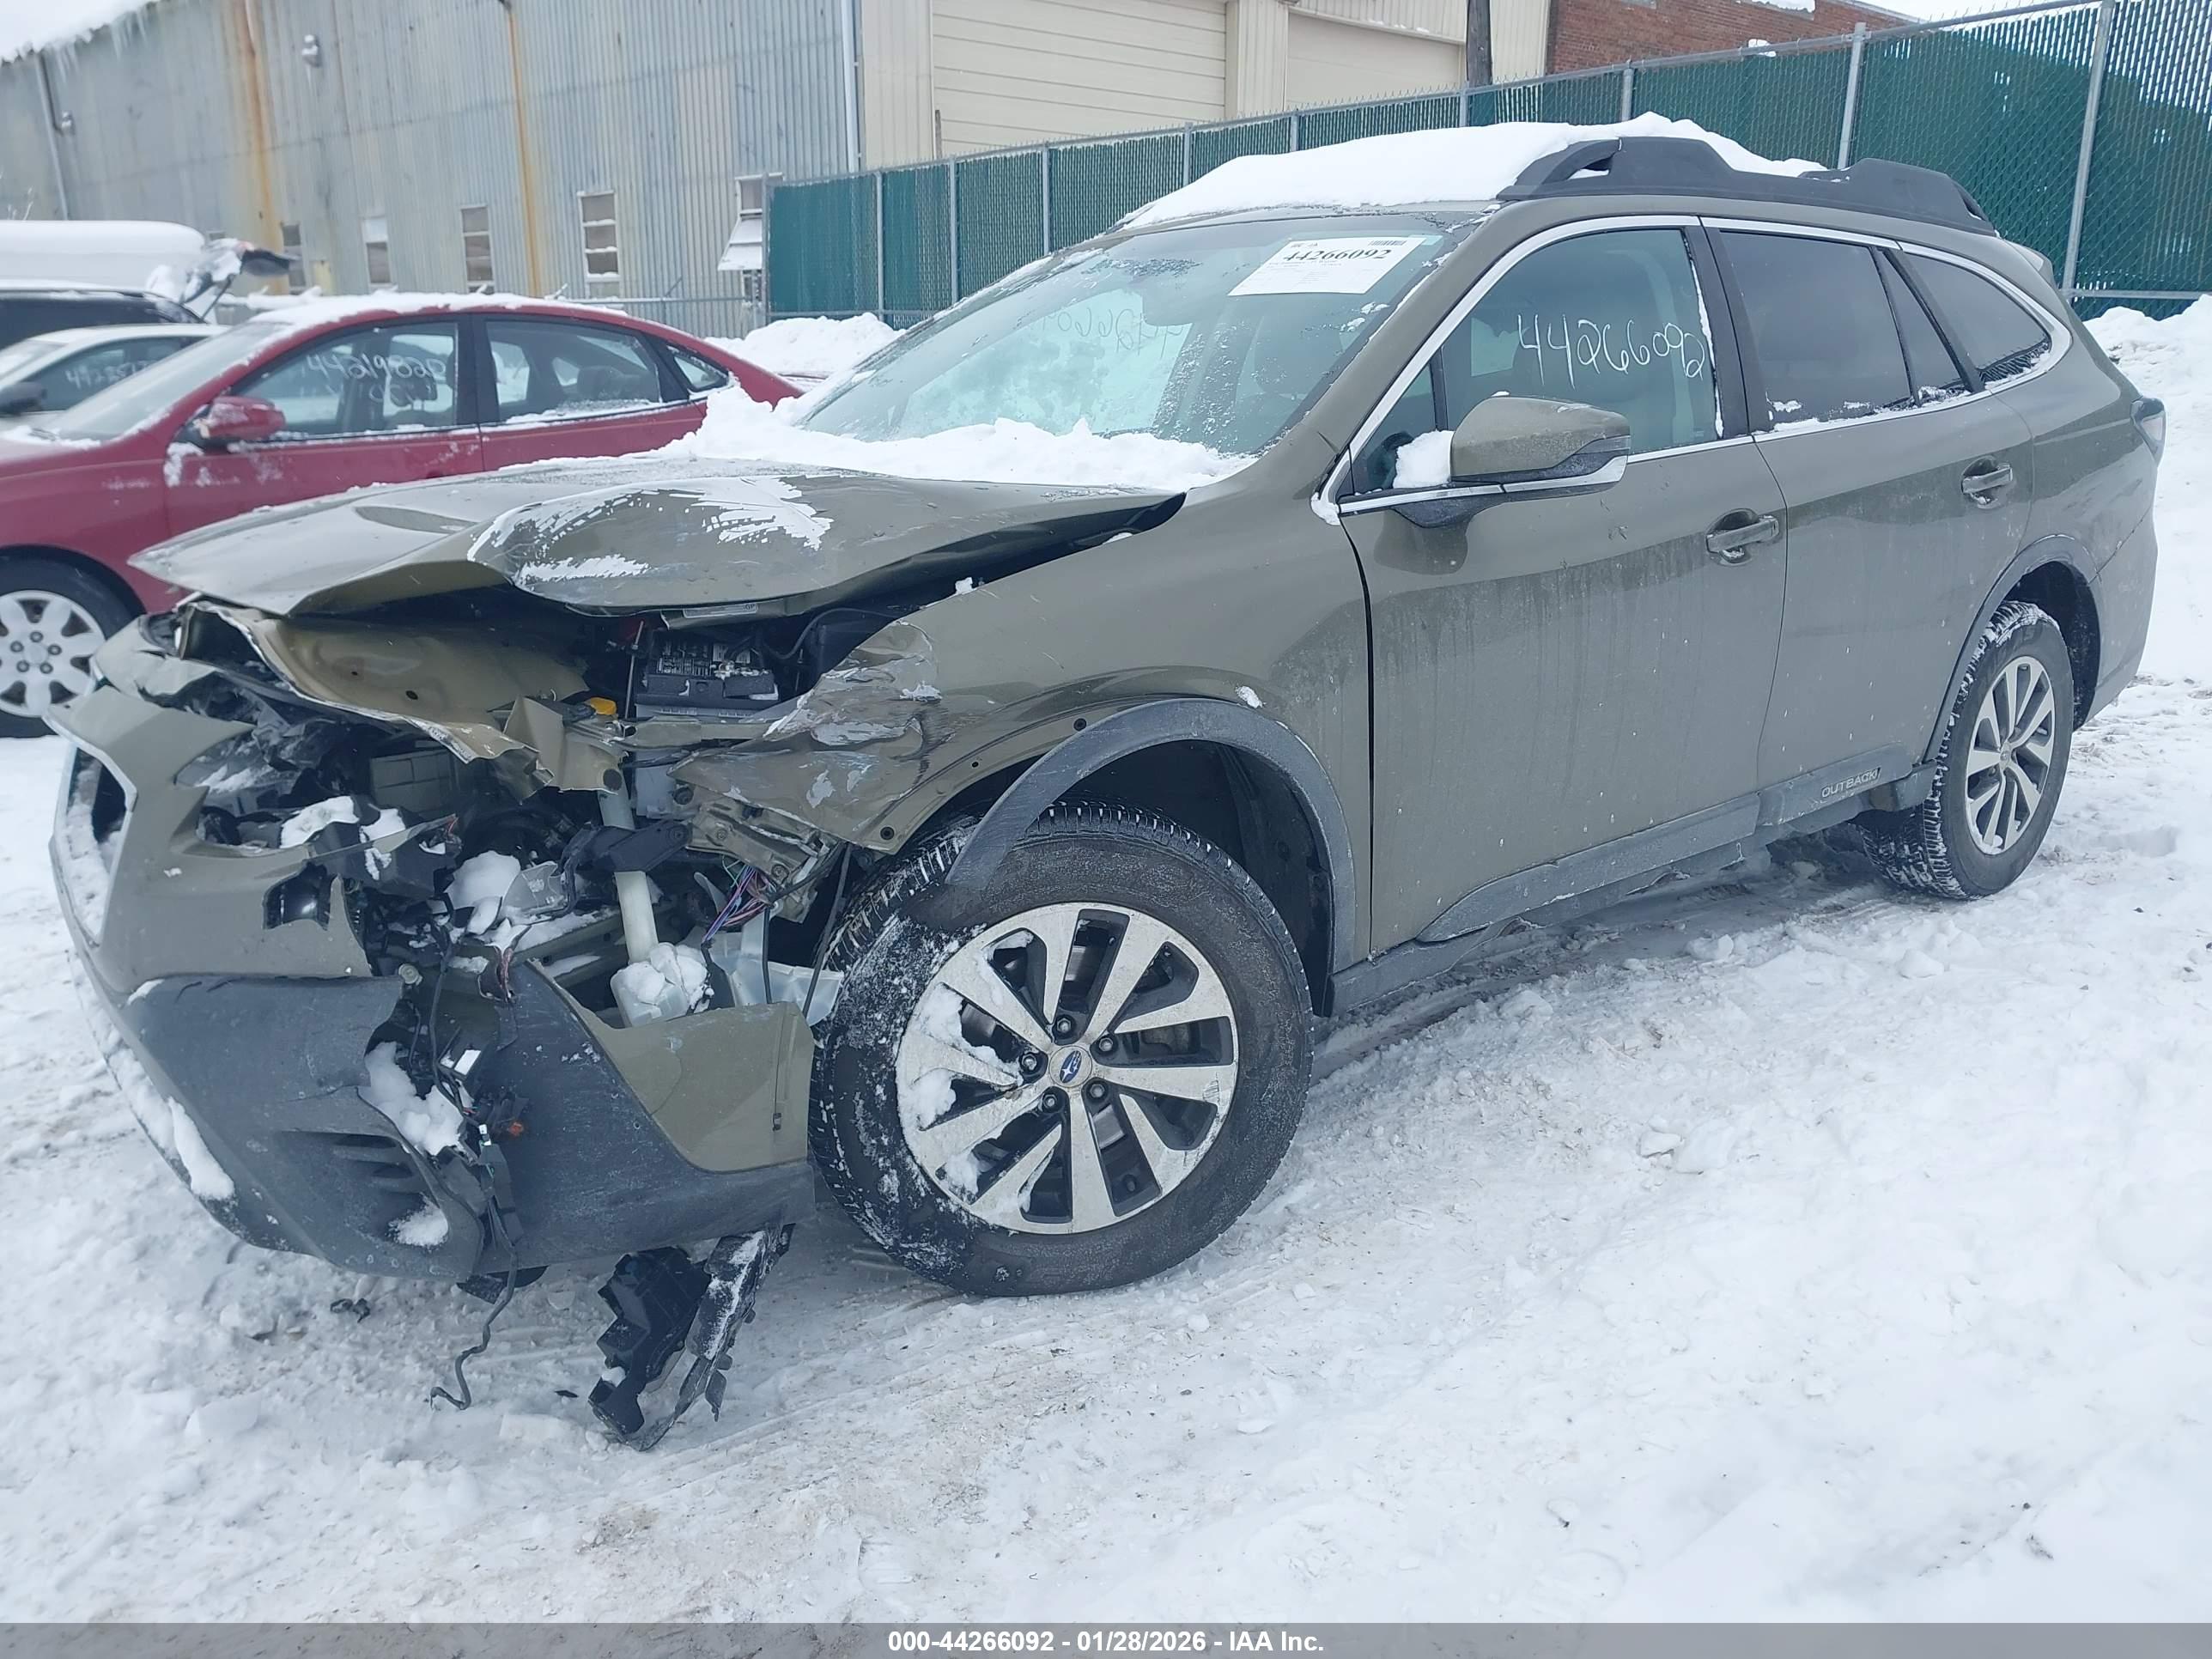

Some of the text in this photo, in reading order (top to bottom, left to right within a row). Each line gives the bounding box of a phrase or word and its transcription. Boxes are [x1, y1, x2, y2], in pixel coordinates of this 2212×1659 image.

[1283, 248, 1393, 261] 44266092
[1517, 313, 1705, 391] 44266092
[1821, 769, 1879, 798] OUTBACK
